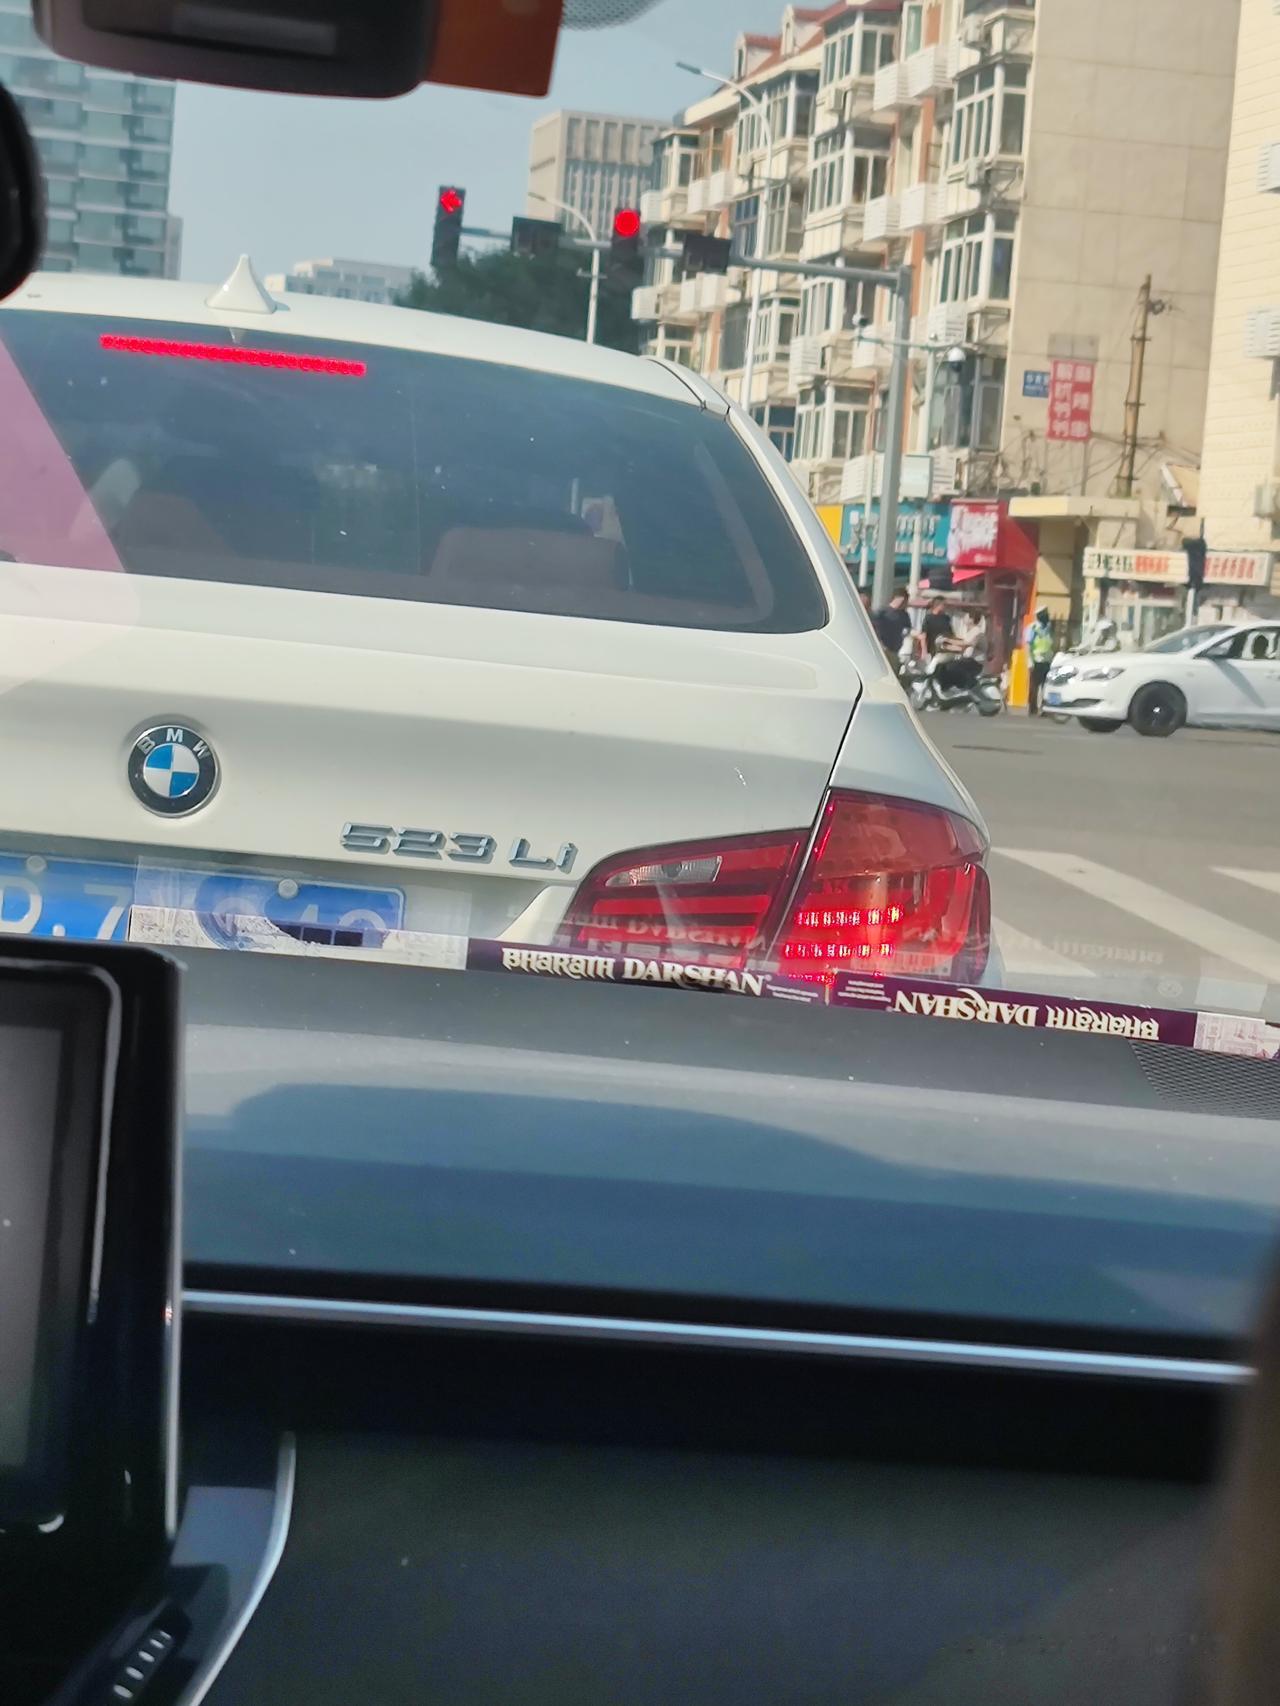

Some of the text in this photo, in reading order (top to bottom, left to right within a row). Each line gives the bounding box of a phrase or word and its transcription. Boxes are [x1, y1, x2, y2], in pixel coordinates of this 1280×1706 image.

[137, 728, 211, 760] BMW
[622, 957, 764, 996] DARSHAN
[894, 988, 1038, 1028] DARSHAN
